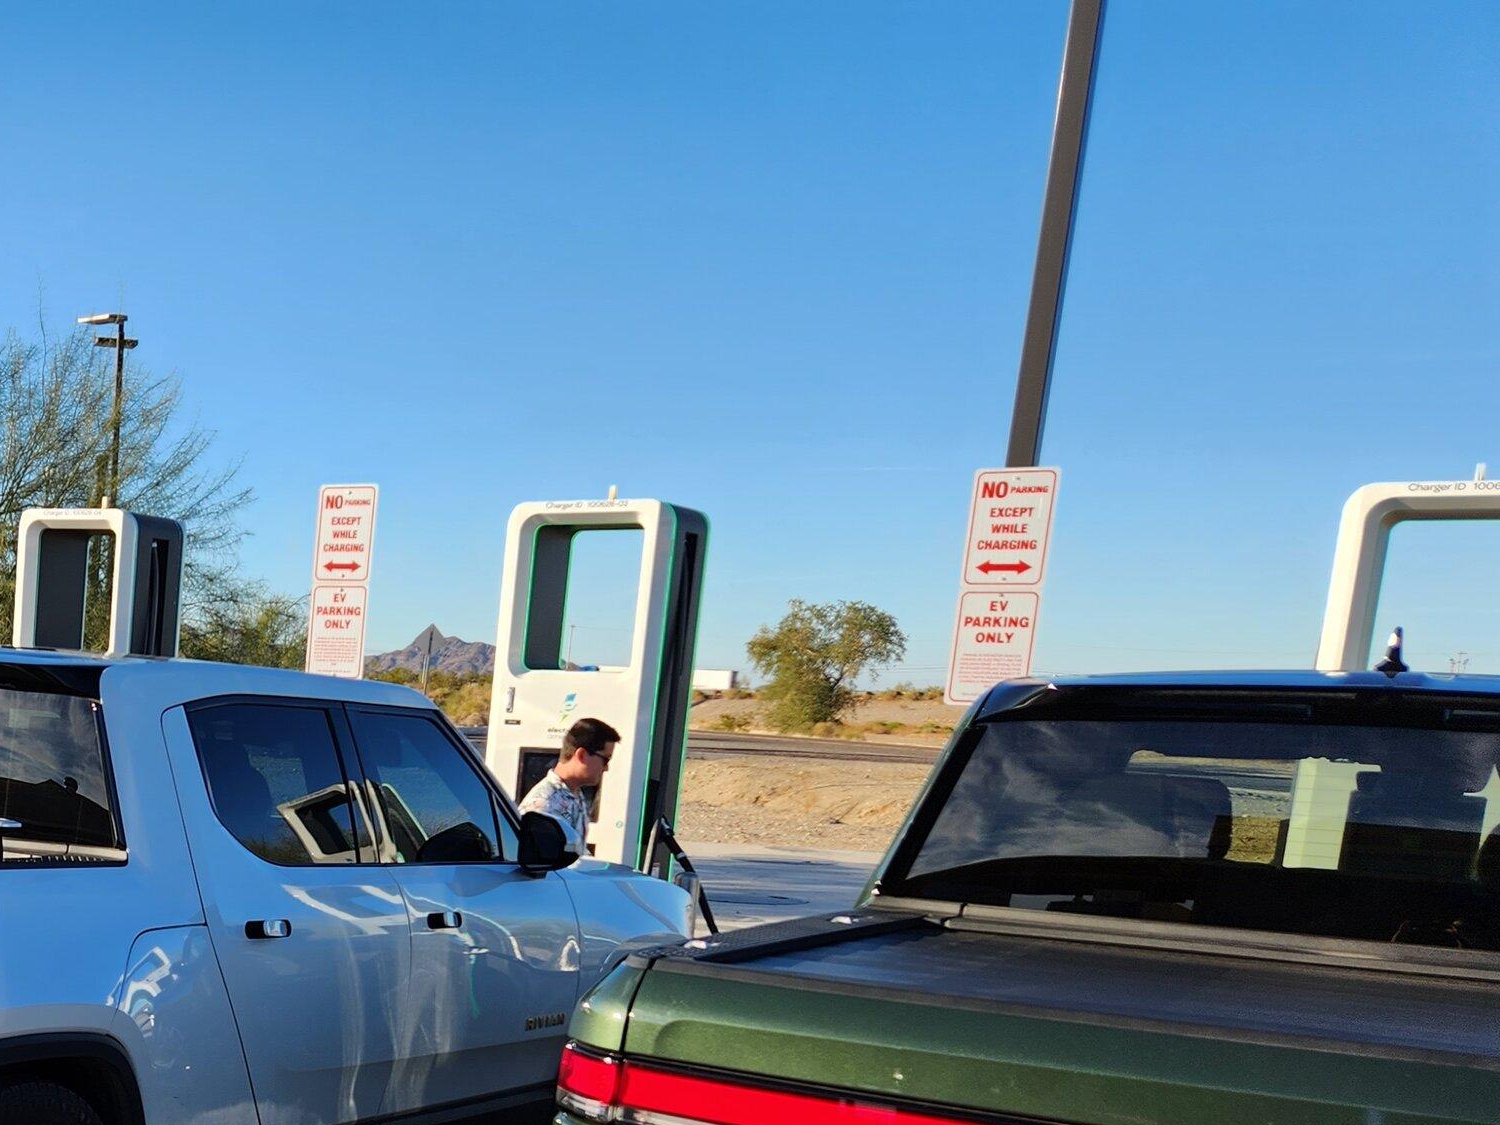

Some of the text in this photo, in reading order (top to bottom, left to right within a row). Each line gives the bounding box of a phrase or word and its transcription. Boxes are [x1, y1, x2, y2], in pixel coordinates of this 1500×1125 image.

[981, 481, 1049, 499] NO PARKING
[1407, 482, 1448, 493] Charger
[1454, 482, 1467, 491] ID
[325, 495, 343, 509] NO
[989, 507, 1035, 518] EXCEPT
[331, 517, 361, 526] EXCEPT
[991, 523, 1028, 534] WHILE
[332, 530, 358, 539] WHILE
[323, 543, 365, 552] CHARGING
[977, 540, 1038, 550] CHARGING
[333, 593, 347, 602] EV
[316, 606, 361, 616] PARKING
[989, 600, 1009, 612] EV
[324, 619, 351, 629] ONLY
[963, 617, 1029, 628] PARKING
[975, 633, 1014, 643] ONLY
[524, 1012, 566, 1032] RIVIAN
